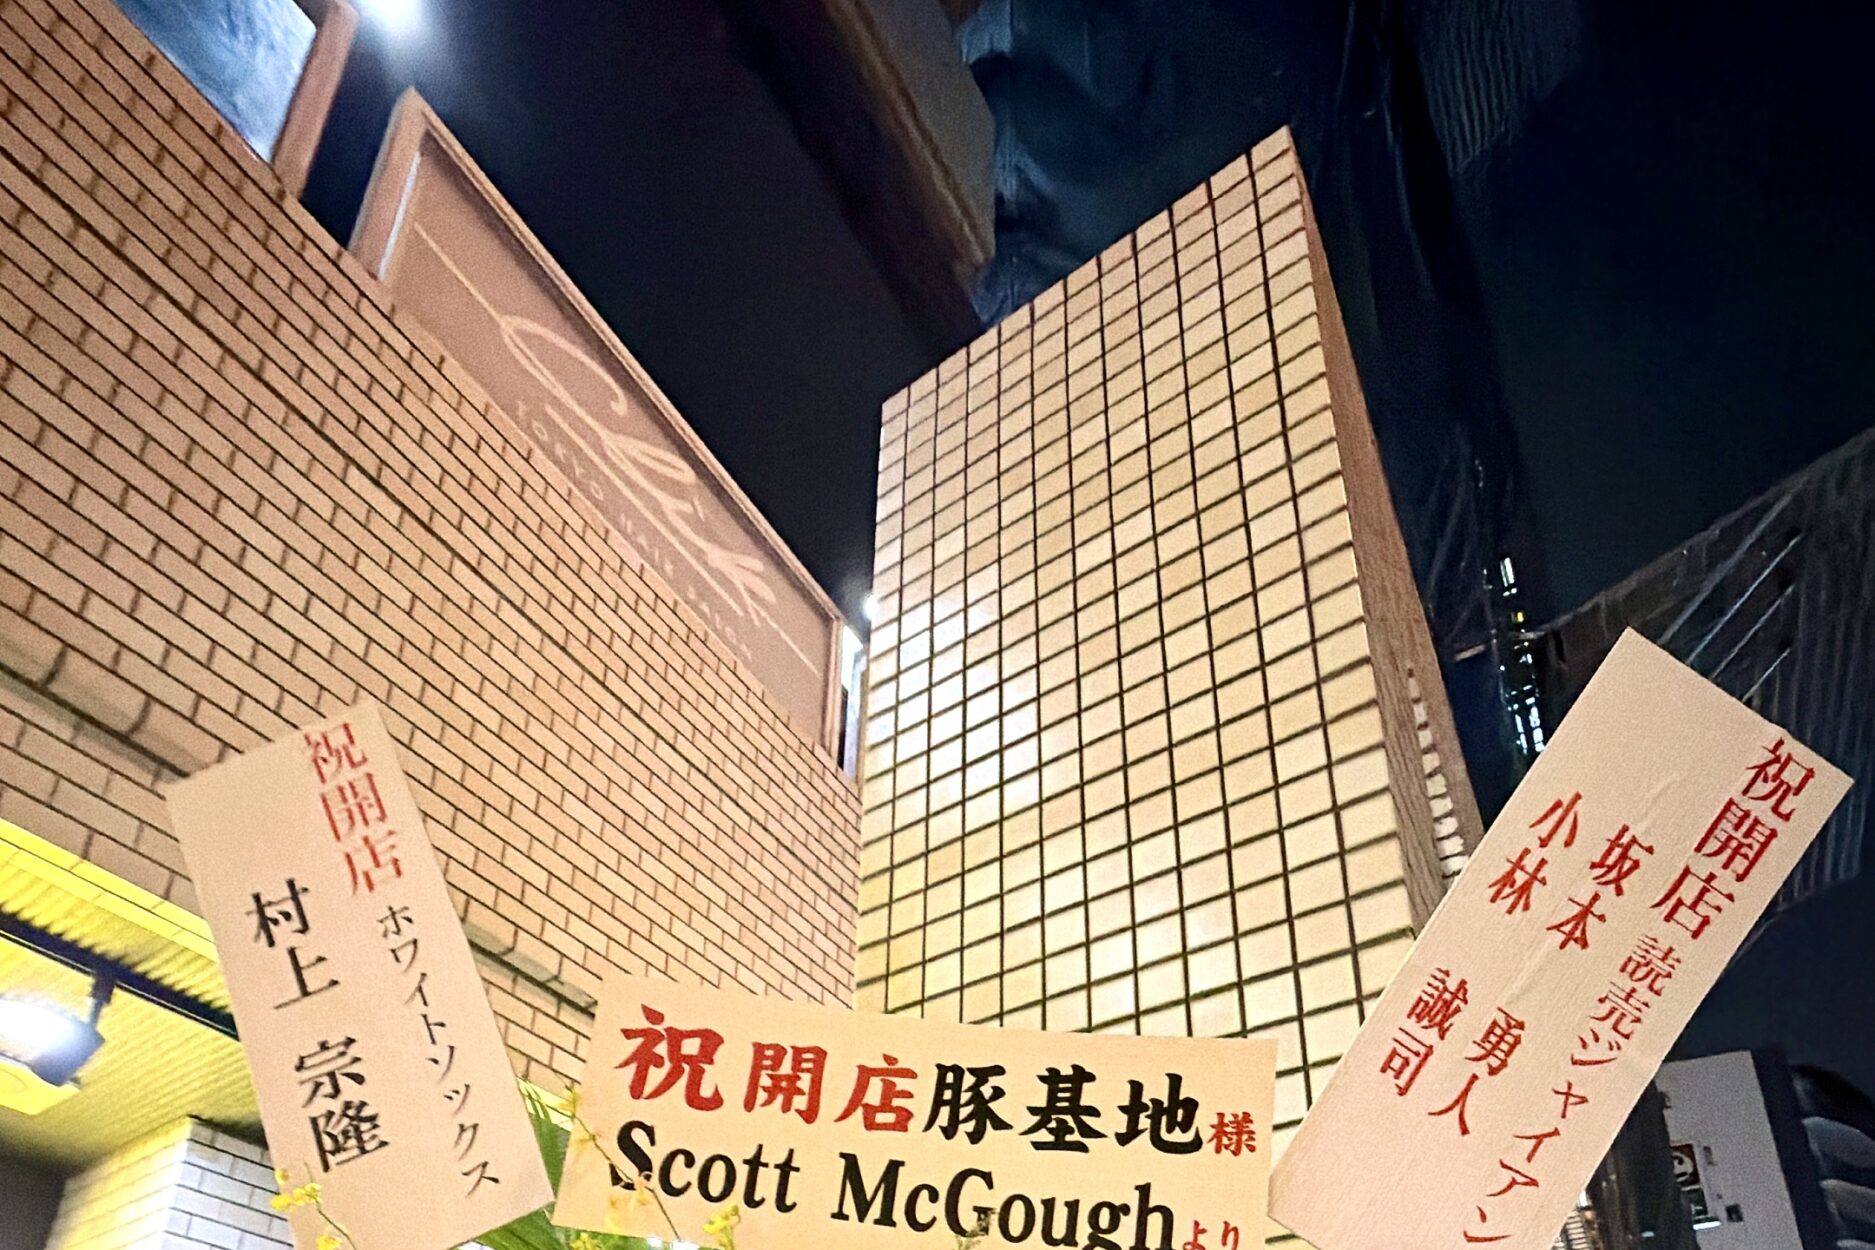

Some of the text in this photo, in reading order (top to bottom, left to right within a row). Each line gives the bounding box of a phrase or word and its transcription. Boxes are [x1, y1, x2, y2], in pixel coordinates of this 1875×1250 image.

[515, 400, 605, 501] TOKYO
[304, 721, 501, 1199] 祝開店 ホワイトソックス
[1379, 790, 1579, 1097] 小林 誠司
[1428, 823, 1656, 1138] 坂本 勇人
[1651, 737, 1816, 942] 祝開店
[245, 877, 389, 1174] 村上 宗隆
[608, 1119, 800, 1214] Scott
